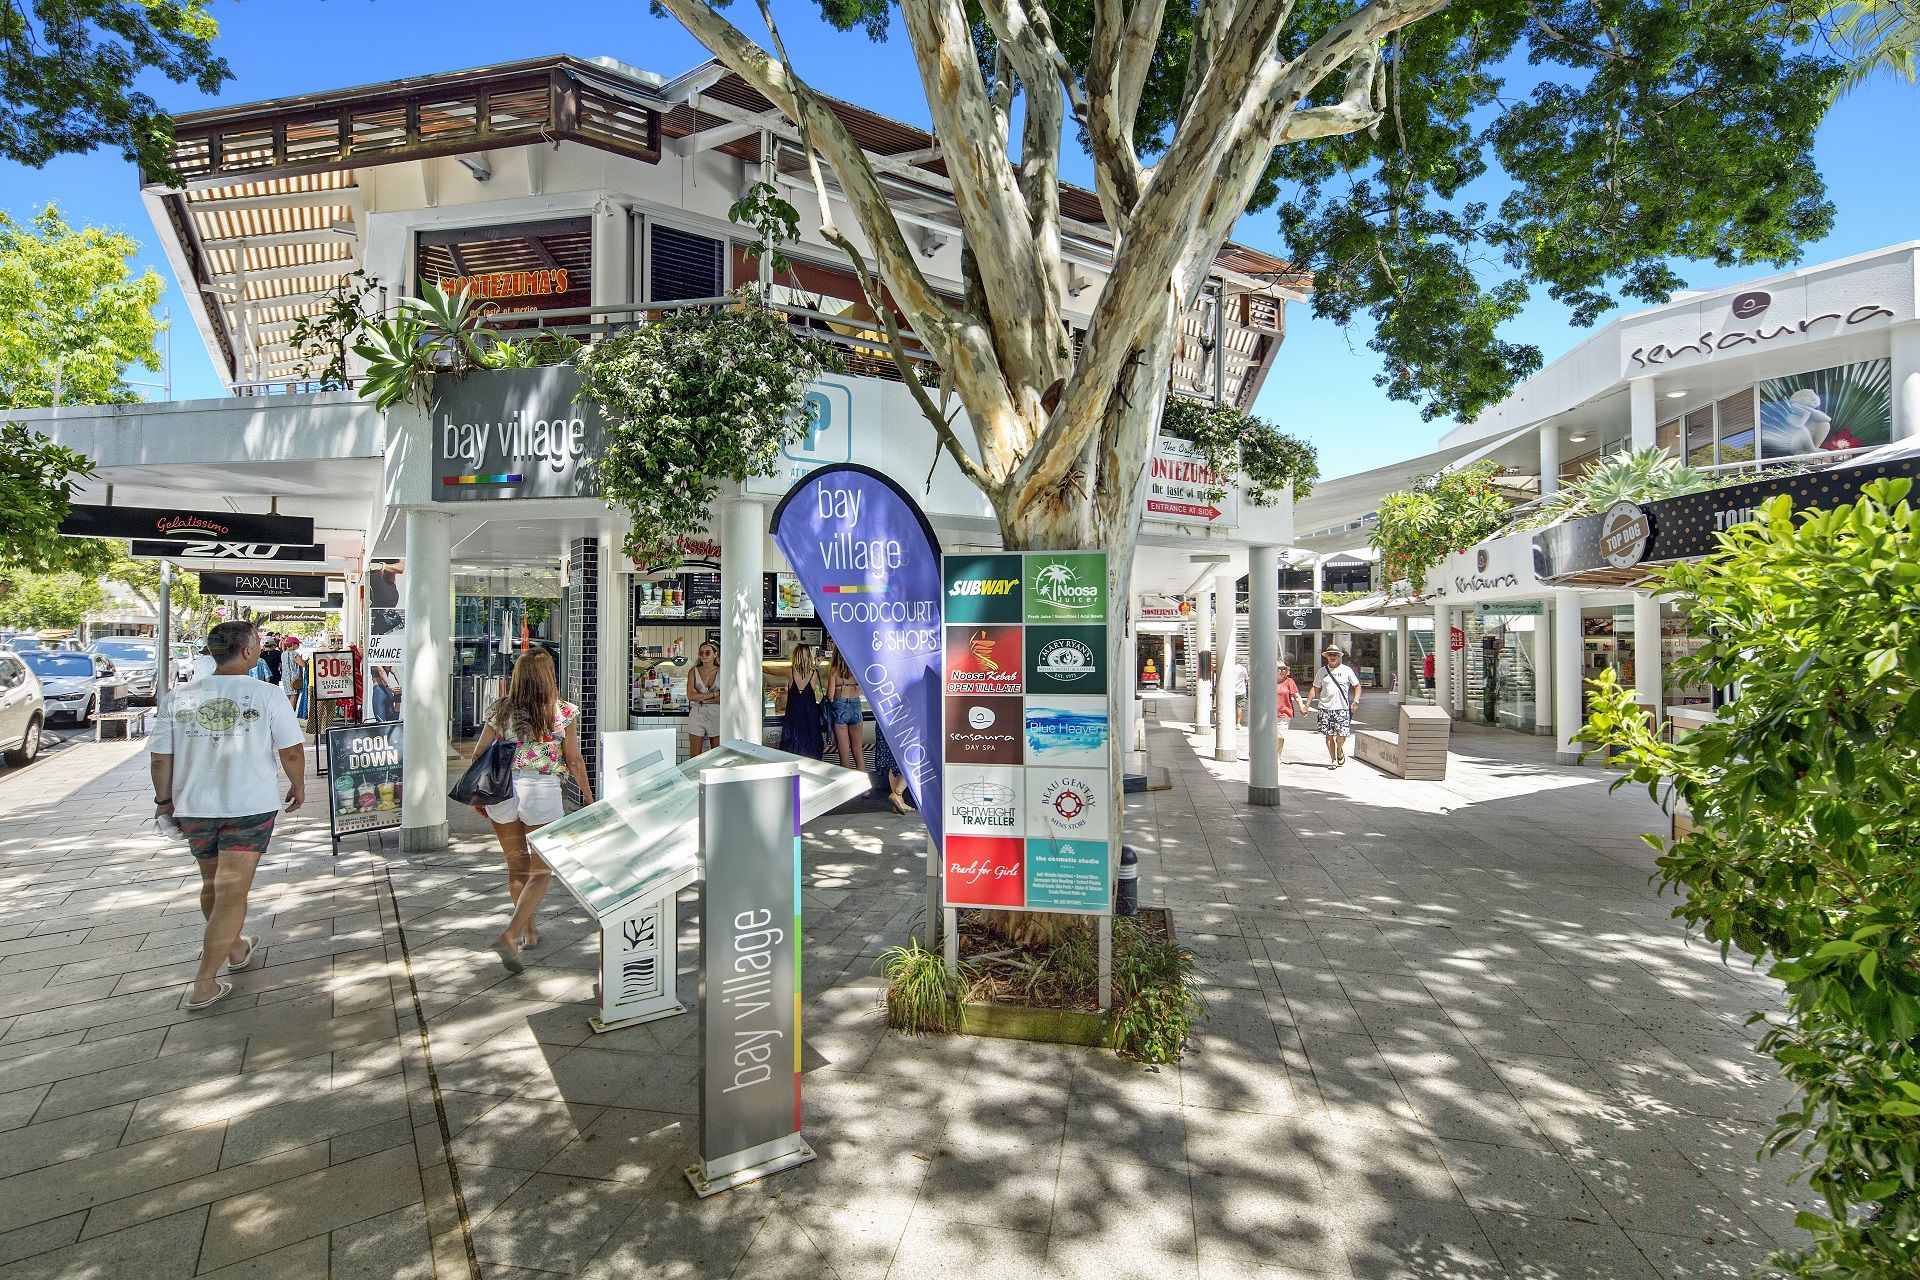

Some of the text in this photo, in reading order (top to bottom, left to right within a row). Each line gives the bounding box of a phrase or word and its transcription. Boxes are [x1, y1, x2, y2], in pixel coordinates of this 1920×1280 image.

[441, 268, 568, 300] MONTEZUMA'S
[1631, 304, 1894, 368] sensaura
[443, 409, 585, 471] bay village
[1163, 441, 1176, 452] The
[1152, 483, 1164, 495] the
[1166, 484, 1184, 497] taste
[817, 482, 862, 528] bay
[1150, 502, 1214, 516] ENTRANCE AT SIDE
[156, 514, 230, 535] Gelatissimo
[1605, 523, 1642, 553] TOP DOG
[181, 541, 282, 559] 2XU
[819, 533, 902, 579] village
[235, 576, 291, 590] PARALLEL
[948, 579, 1020, 597] SUBWAY
[1057, 585, 1098, 597] Noosa
[831, 601, 932, 624] FOODCOURT
[369, 637, 381, 648] OF
[872, 629, 937, 651] & SHOPS
[1041, 641, 1065, 658] MARY
[951, 670, 1017, 681] Noosa Kebab
[947, 683, 1021, 693] OPEN TILL LATE
[864, 663, 937, 788] OPEN NOW
[1030, 722, 1104, 734] Blue Heaven
[352, 734, 394, 754] COOL
[949, 732, 1015, 741] sensaura
[349, 749, 399, 770] DOWN
[1042, 777, 1096, 808] BEAU GENTRY
[952, 806, 1016, 817] LIGHTWEIGHT
[962, 815, 1015, 827] TRAVELLER
[1051, 817, 1087, 830] MENS STORE
[950, 861, 976, 874] Pearls
[966, 859, 992, 884] for
[994, 862, 1020, 880] Girls
[722, 908, 785, 1094] bay village
